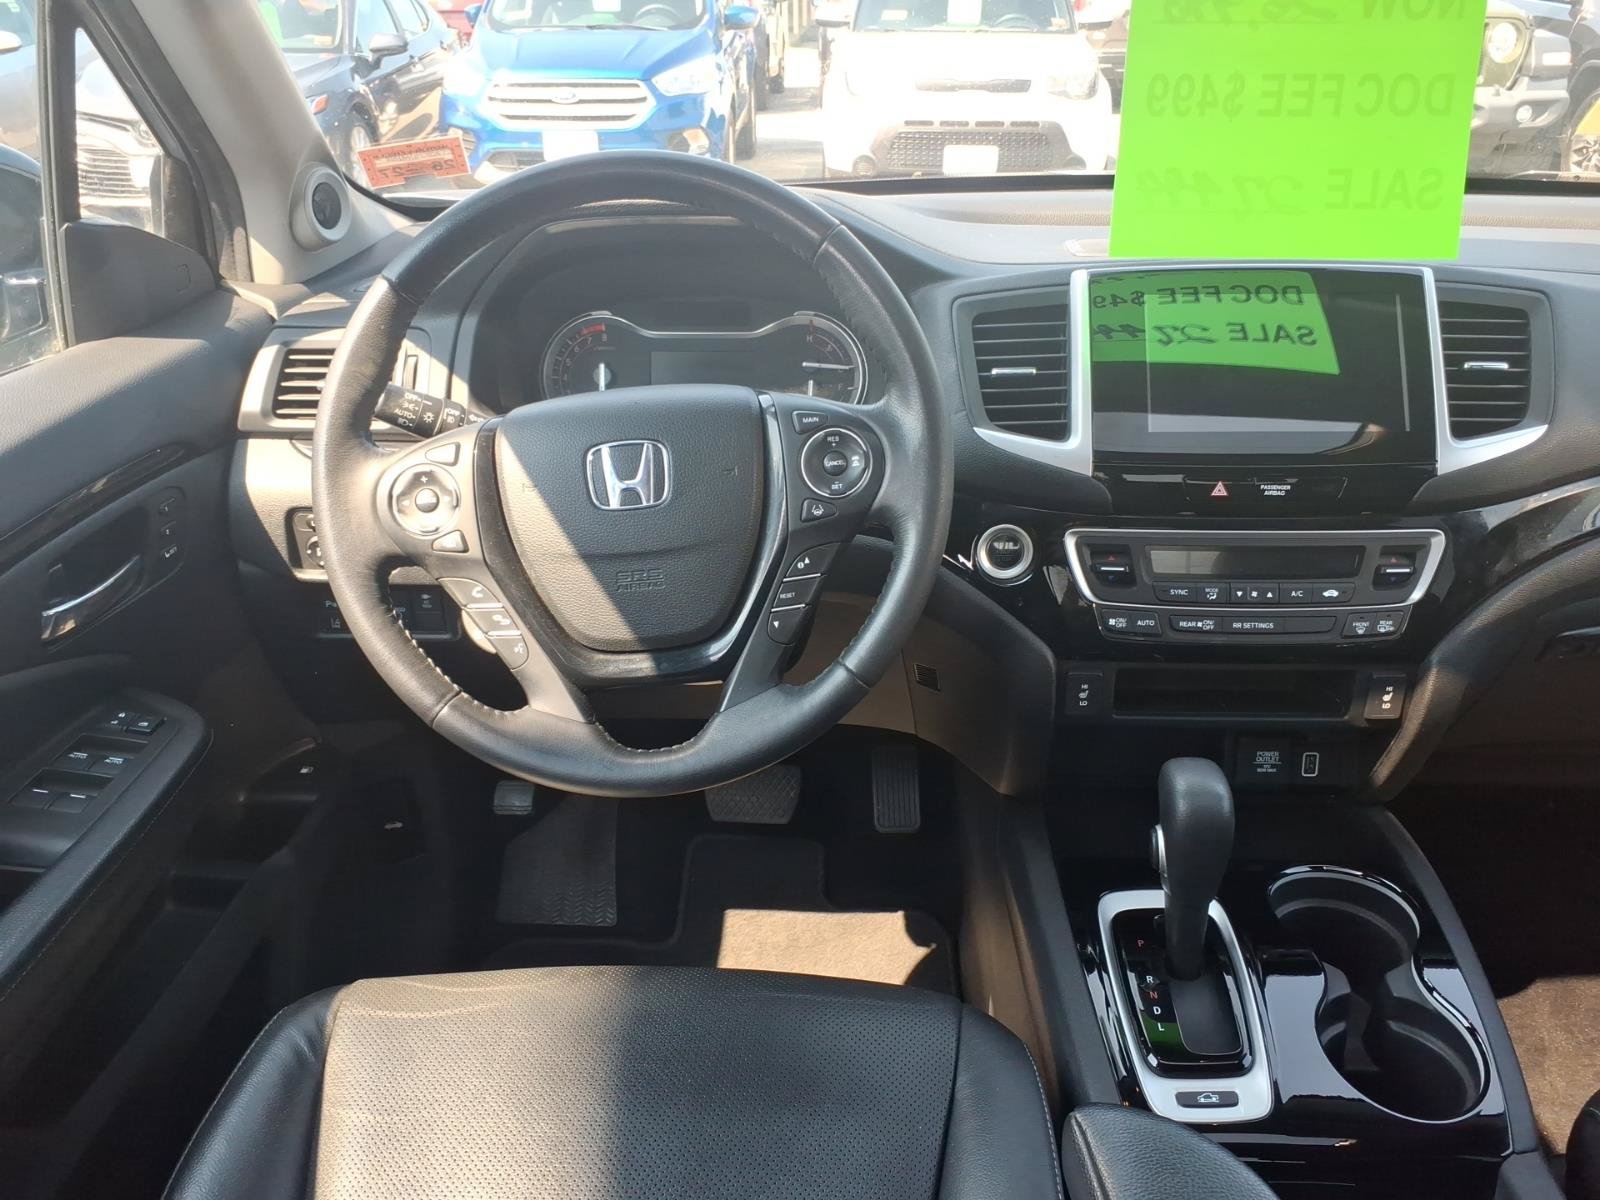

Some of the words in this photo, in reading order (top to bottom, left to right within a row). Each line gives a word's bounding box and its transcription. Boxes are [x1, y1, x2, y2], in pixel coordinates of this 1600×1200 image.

[1169, 588, 1189, 596] SYNC
[1136, 619, 1155, 627] AUTO
[1179, 620, 1196, 628] REAR
[1243, 622, 1274, 630] SETTINGS
[1137, 939, 1145, 948] P
[1146, 975, 1153, 985] R
[1150, 991, 1158, 1000] N
[1153, 1006, 1161, 1015] D
[1158, 1022, 1165, 1031] L
